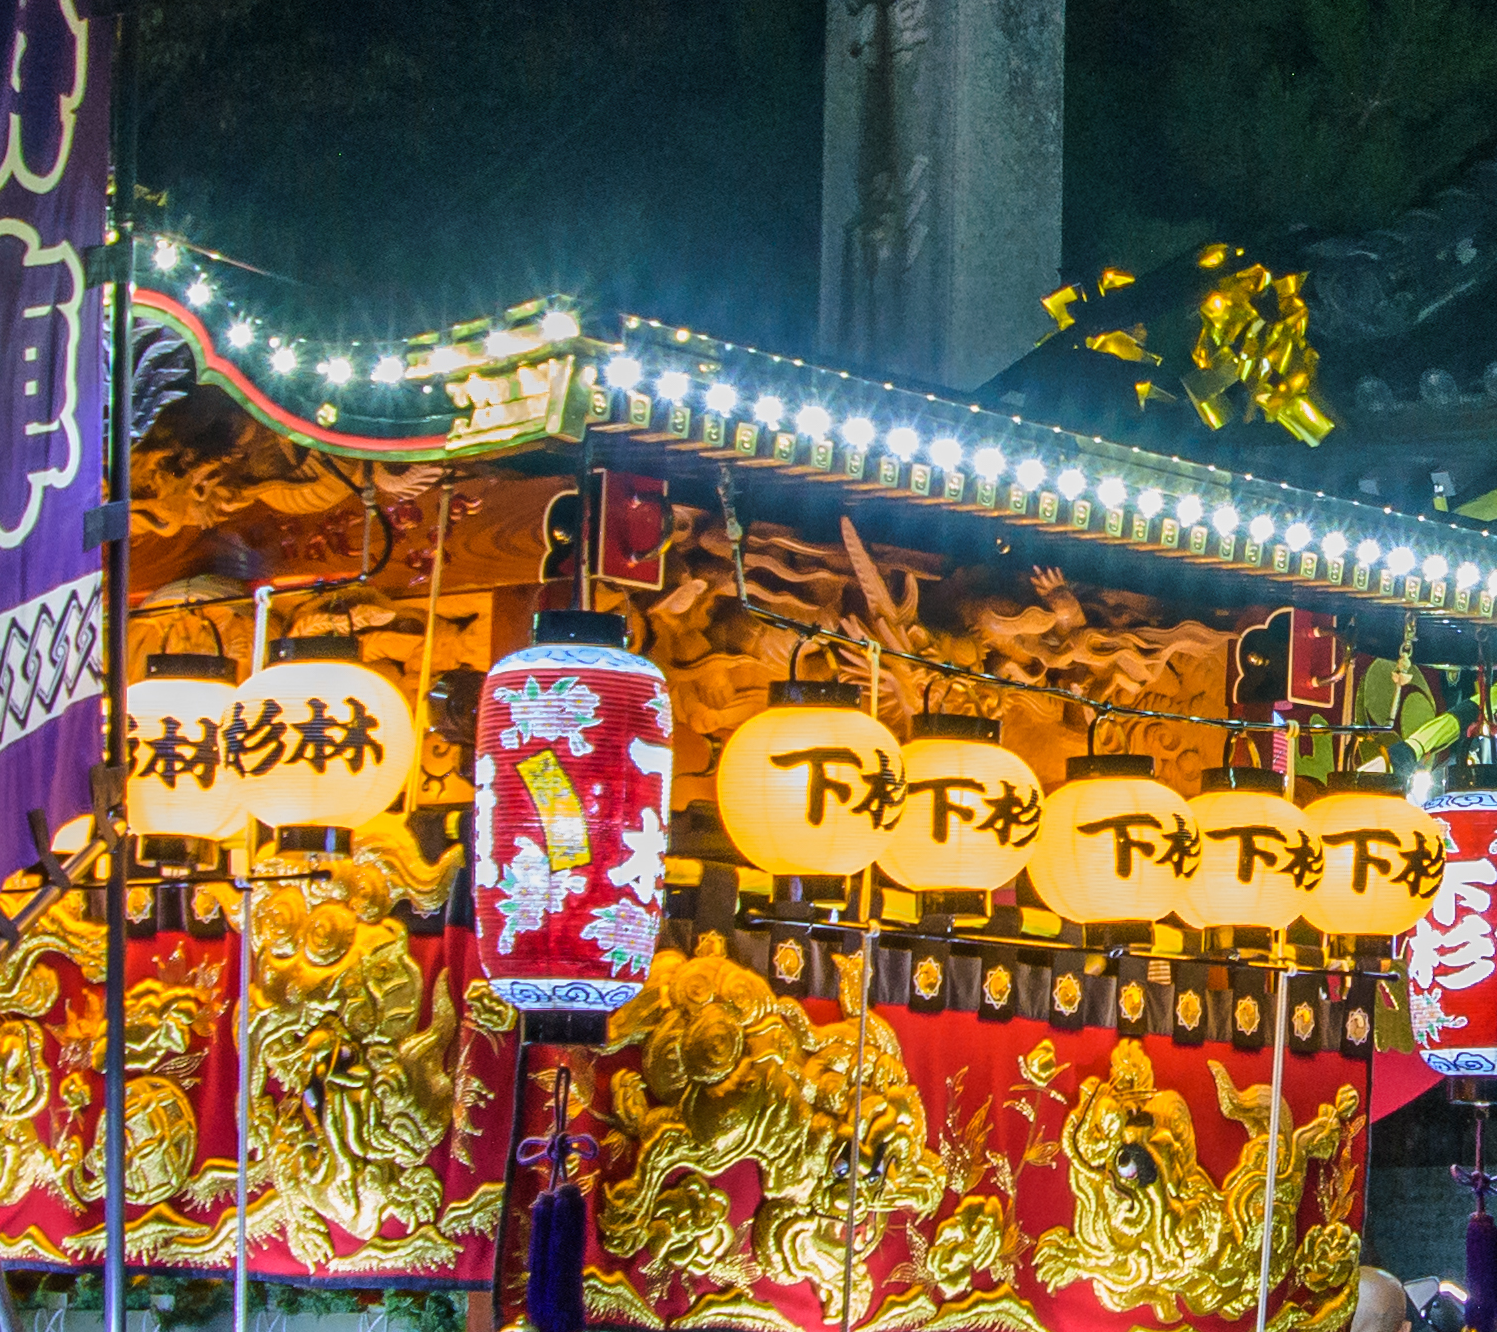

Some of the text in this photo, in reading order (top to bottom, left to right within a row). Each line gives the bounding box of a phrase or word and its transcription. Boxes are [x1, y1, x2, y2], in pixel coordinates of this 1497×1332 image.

[769, 747, 908, 831] 下杉
[907, 777, 1042, 849] 下杉
[1321, 828, 1446, 899] 下杉
